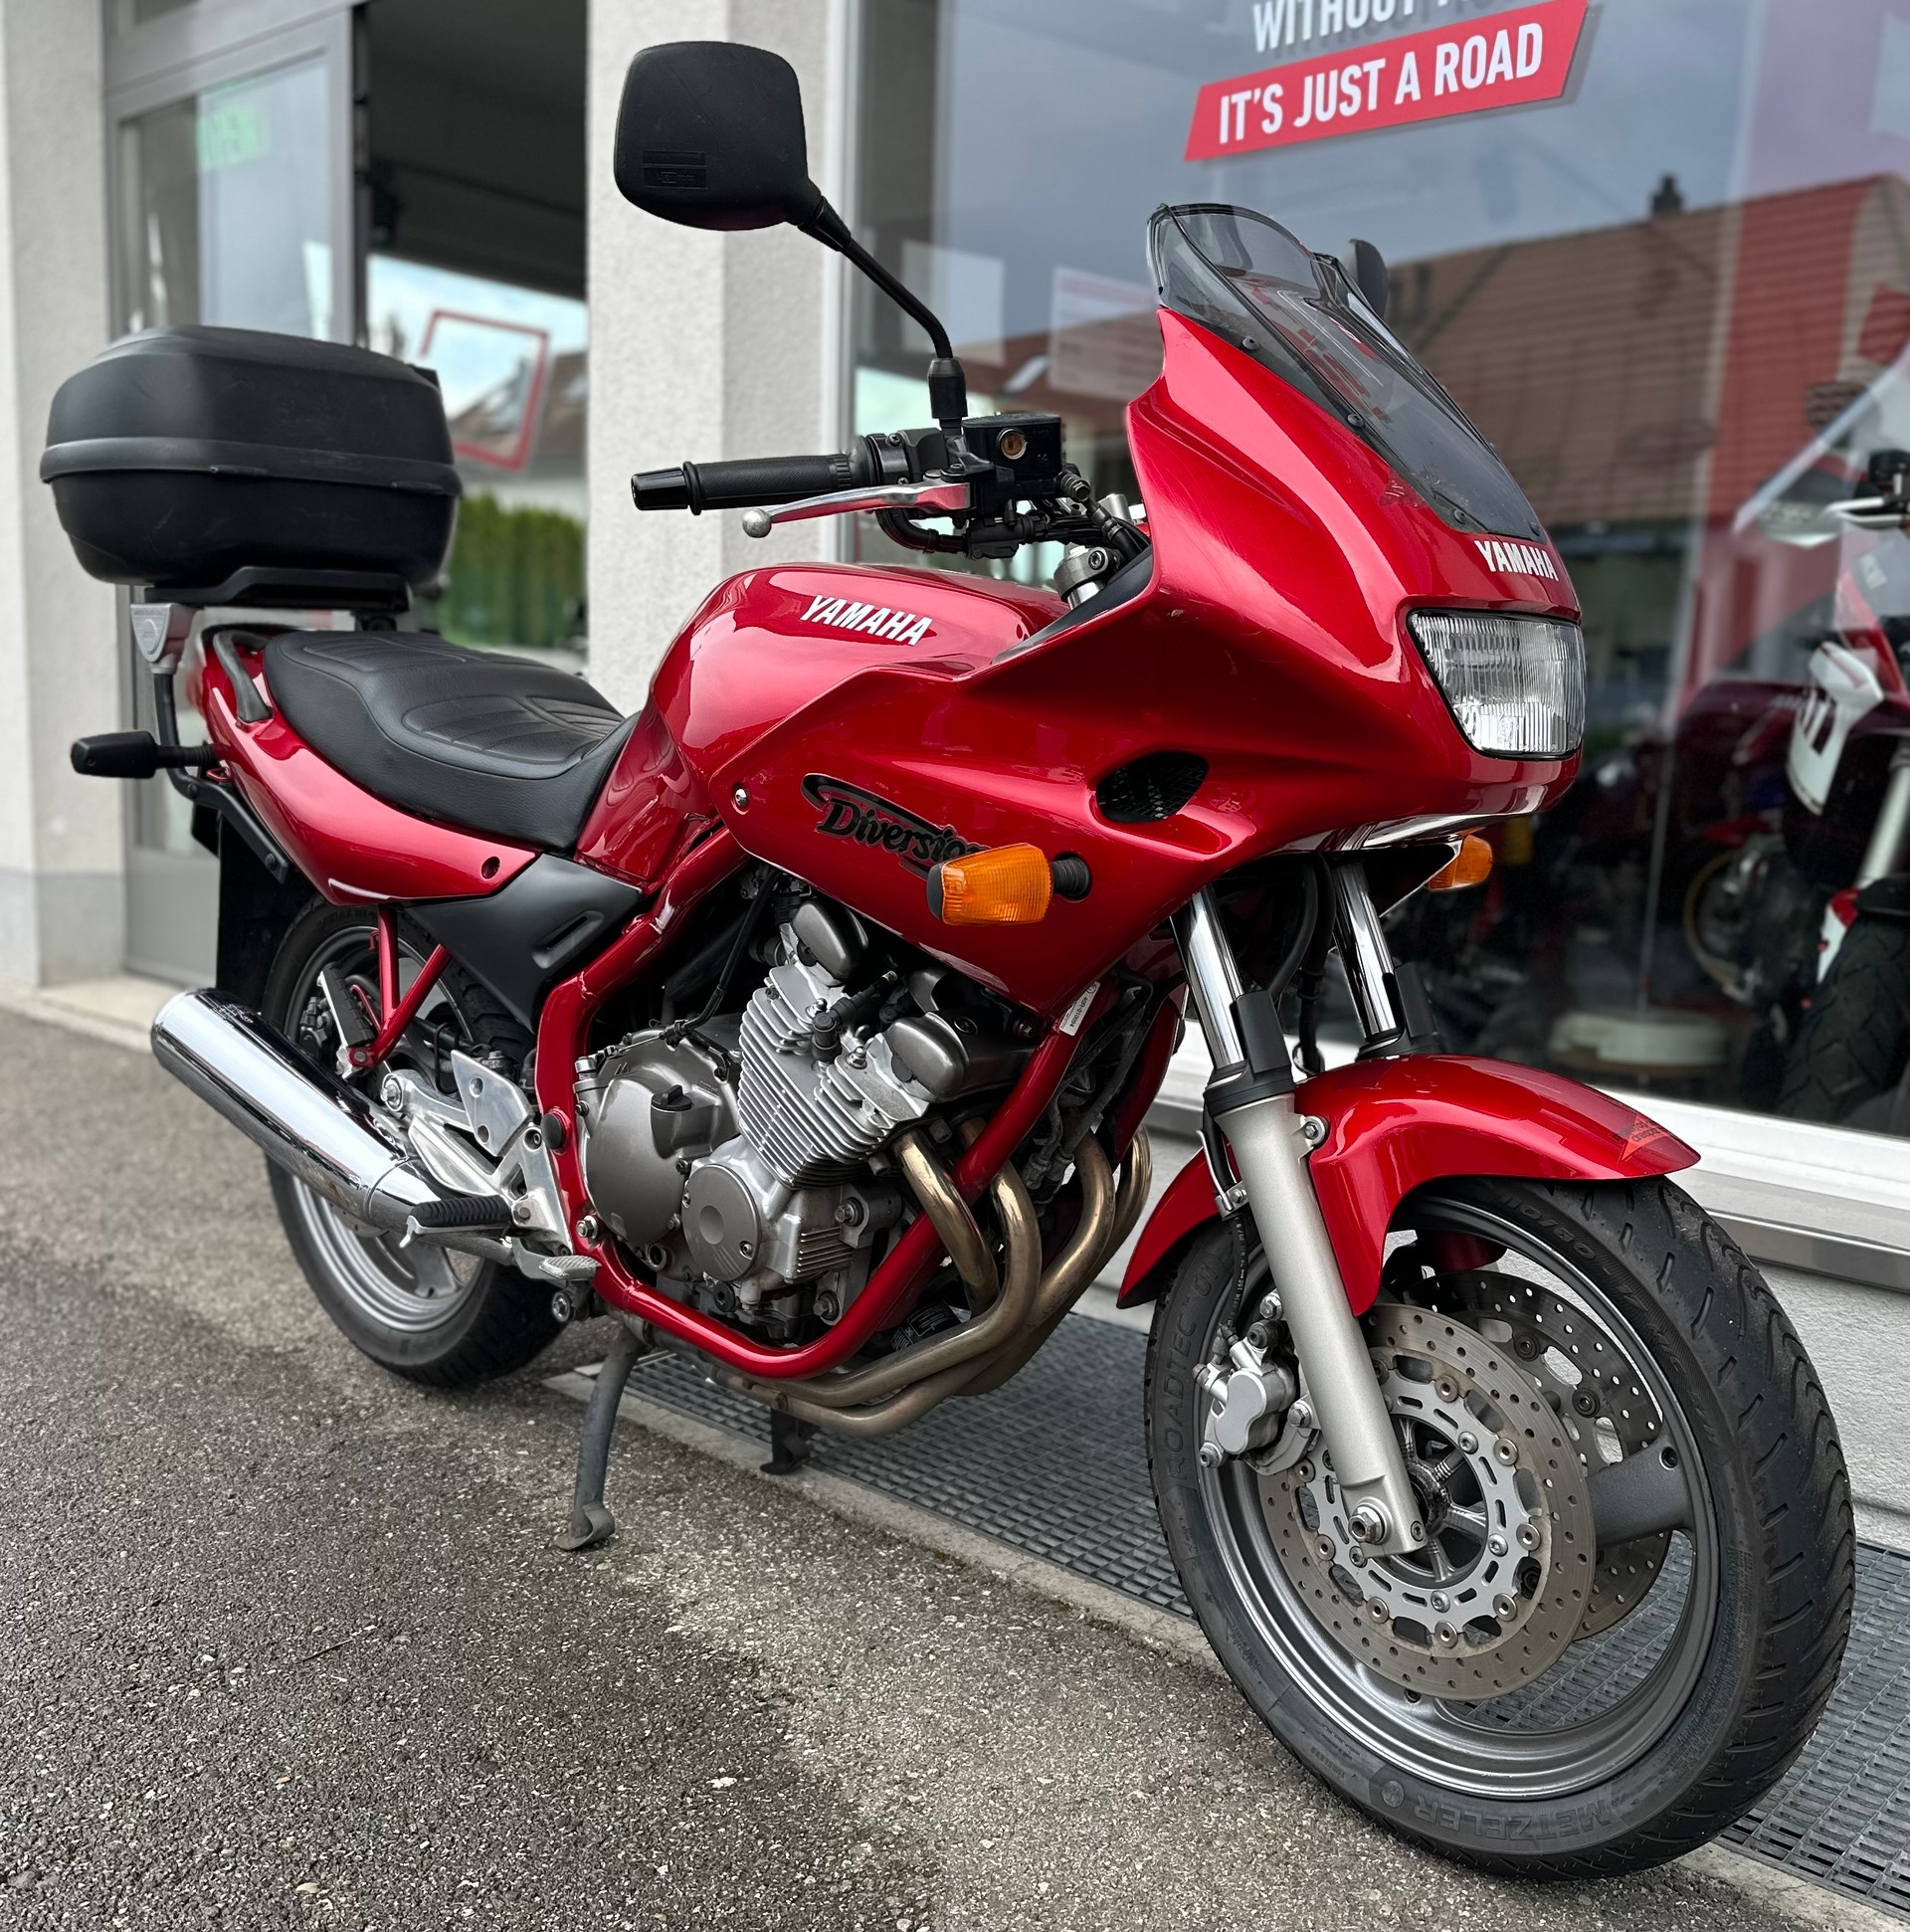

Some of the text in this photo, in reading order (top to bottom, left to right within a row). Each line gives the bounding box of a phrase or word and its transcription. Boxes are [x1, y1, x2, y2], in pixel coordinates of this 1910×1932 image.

[1220, 23, 1543, 144] IT'S JUST A ROAD
[1474, 540, 1559, 582] YAMAHA
[800, 594, 933, 646] YAMAHA
[1161, 1312, 1198, 1481] ROADTEC
[1414, 1794, 1612, 1841] METZELER
